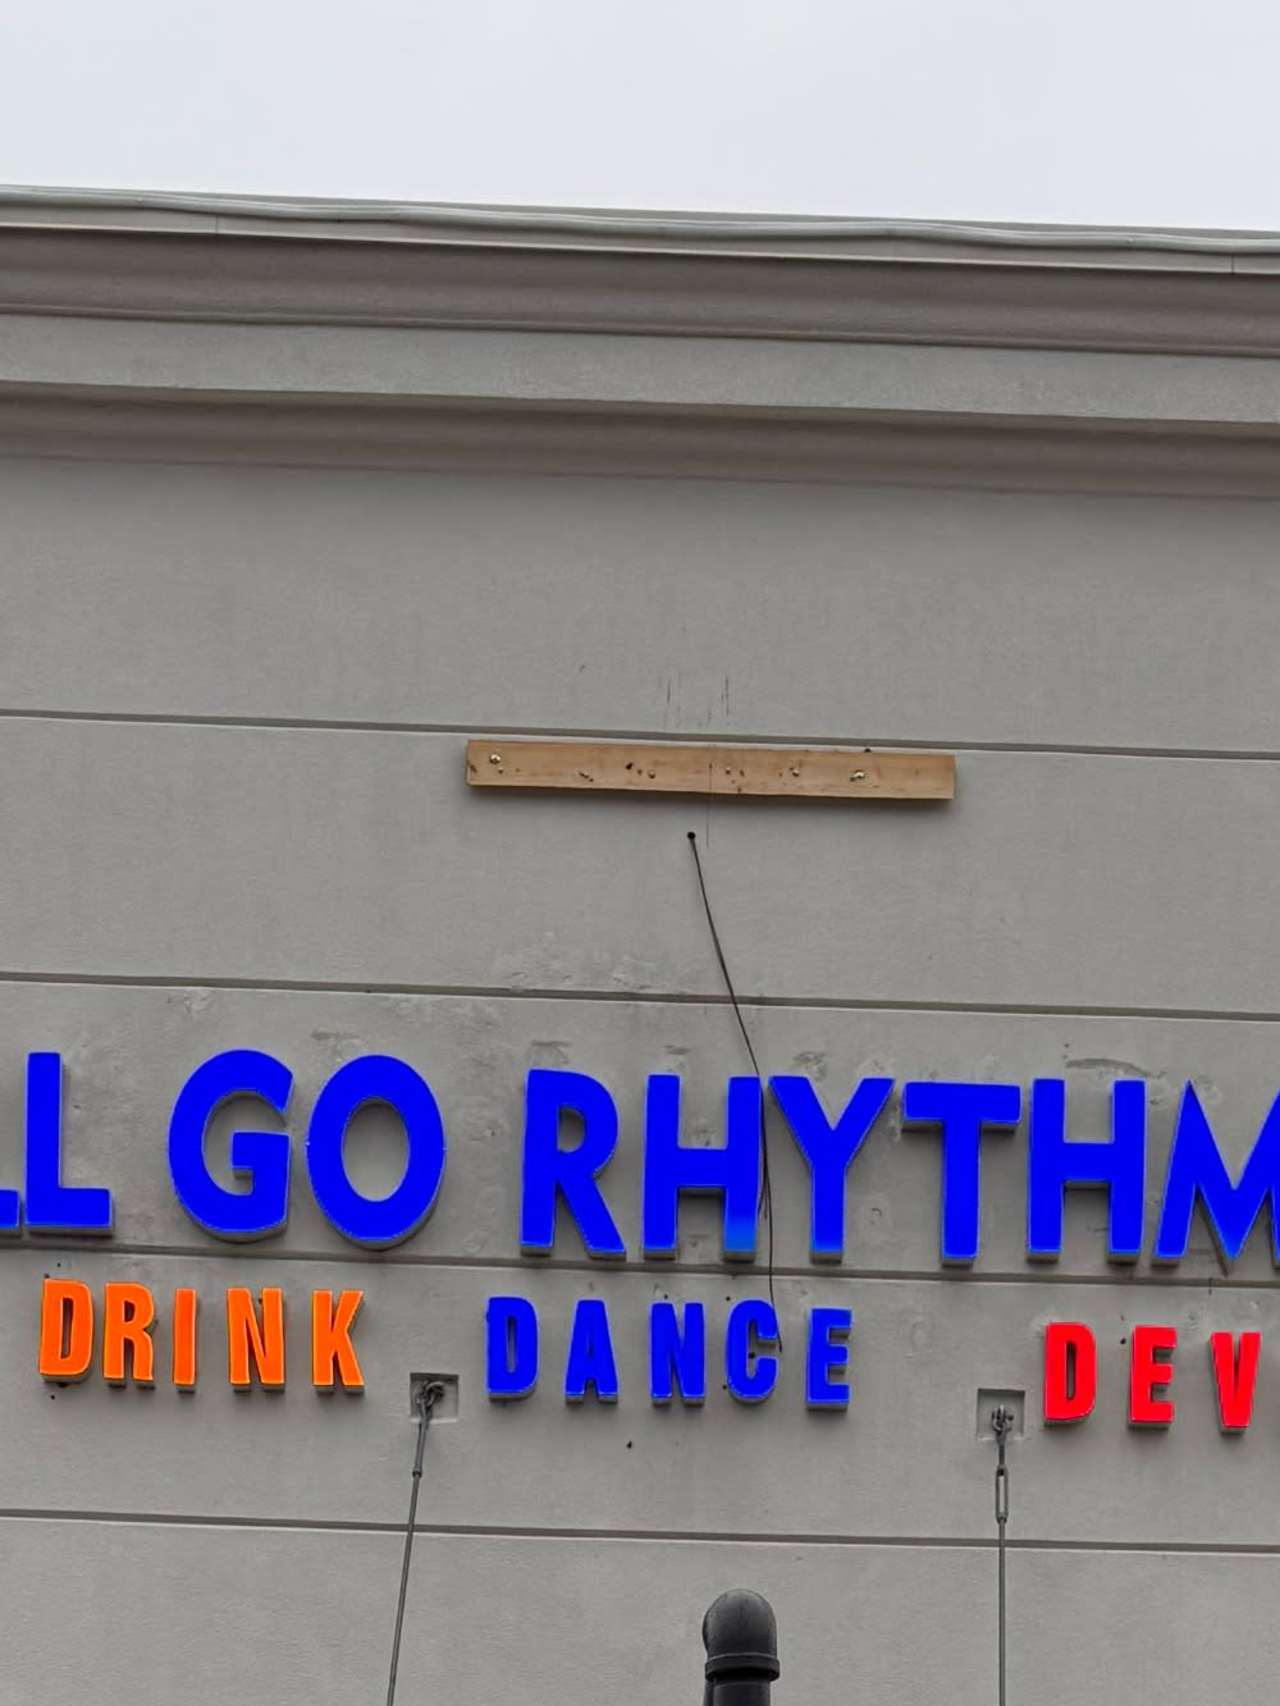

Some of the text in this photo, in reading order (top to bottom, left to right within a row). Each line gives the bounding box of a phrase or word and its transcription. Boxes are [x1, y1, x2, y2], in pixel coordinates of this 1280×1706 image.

[165, 1049, 449, 1249] GO
[37, 1277, 367, 1395] DRINK
[482, 1294, 855, 1412] DANCE
